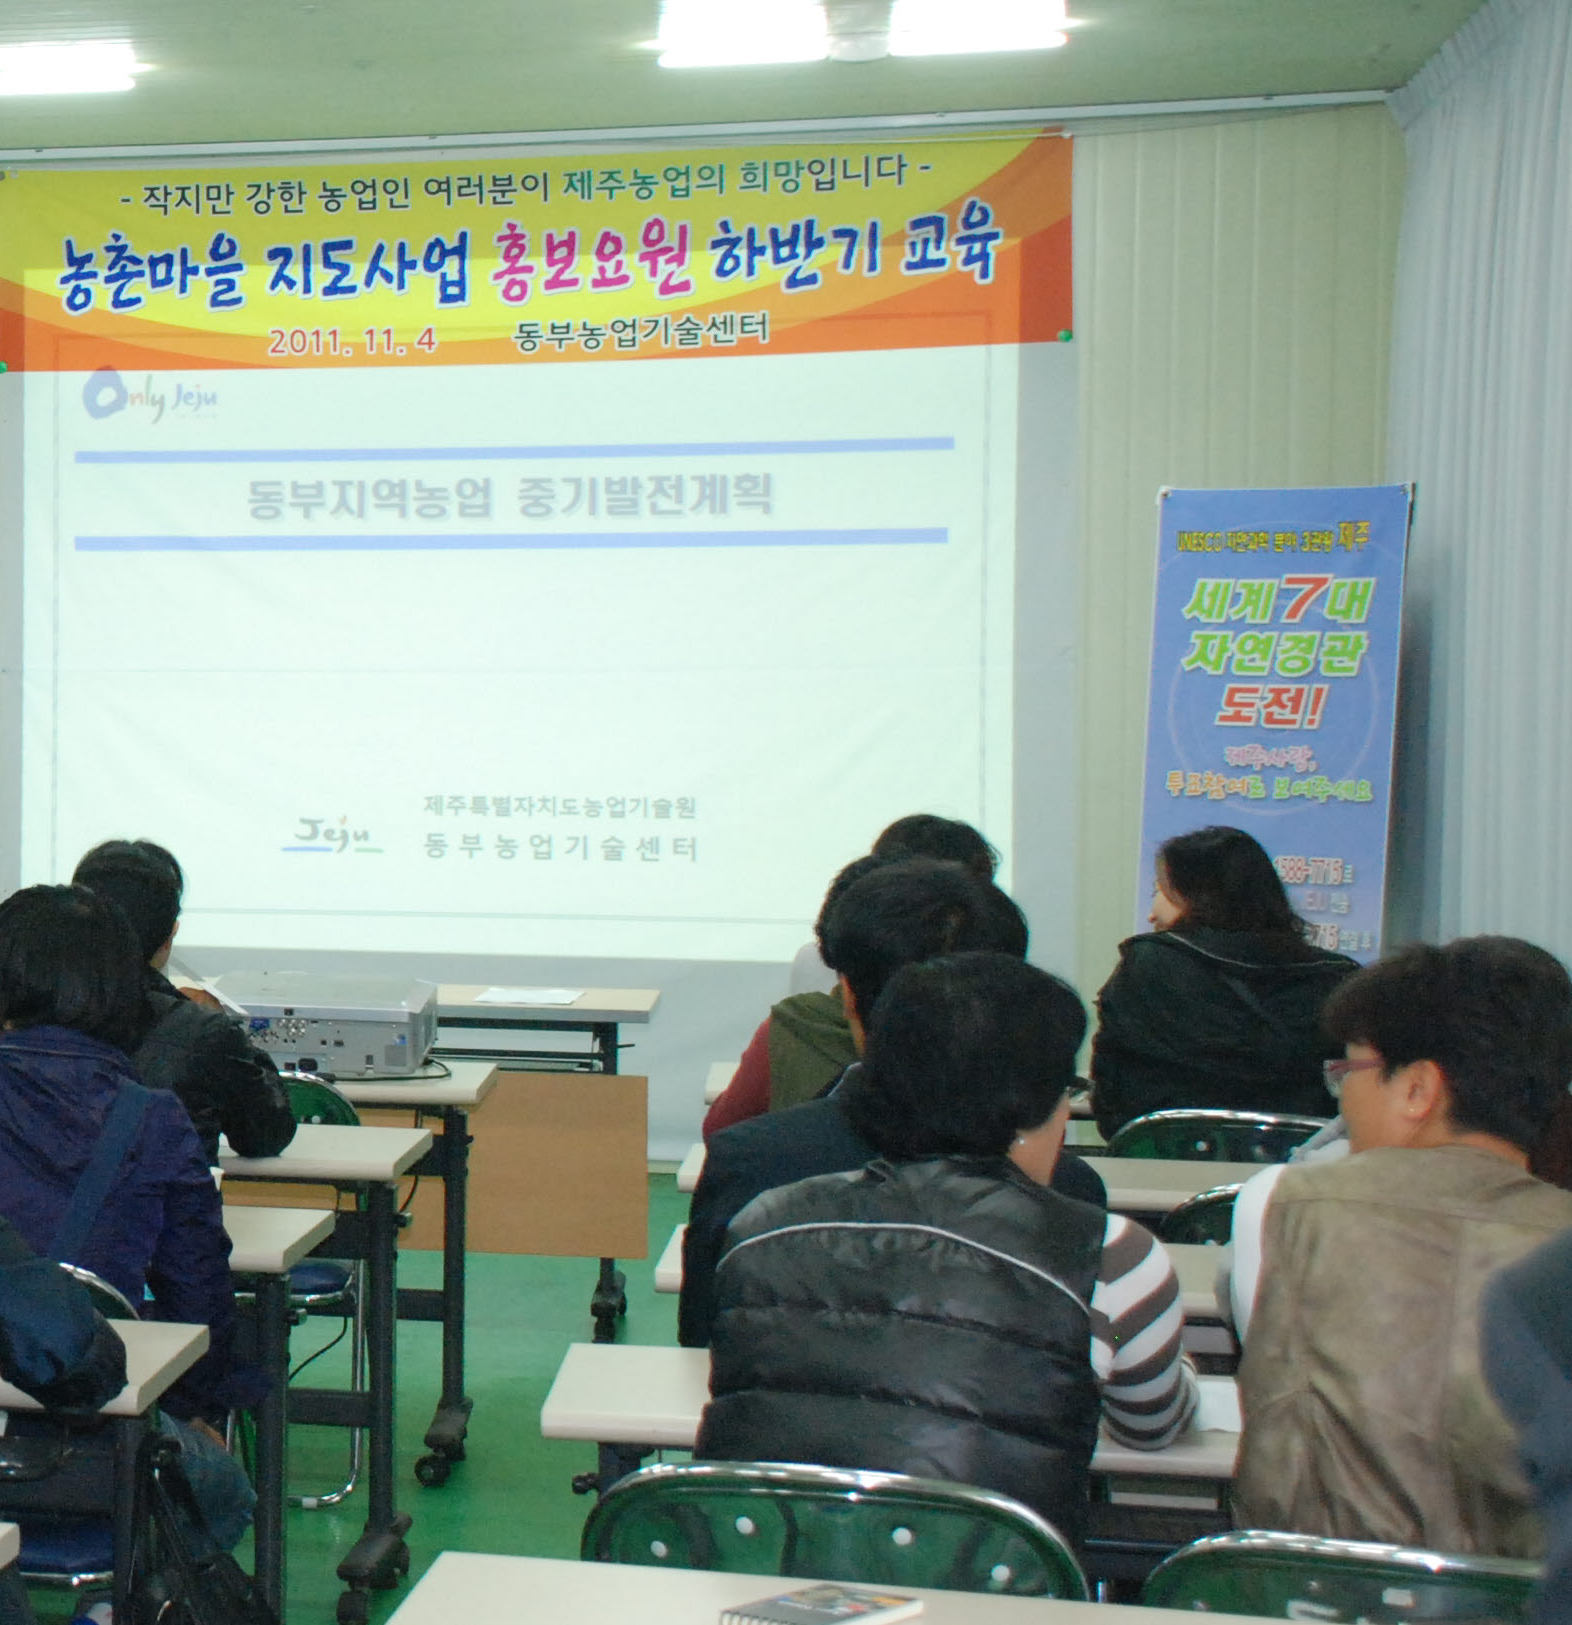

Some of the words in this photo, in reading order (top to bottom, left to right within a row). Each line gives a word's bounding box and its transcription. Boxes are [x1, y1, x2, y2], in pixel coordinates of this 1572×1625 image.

[143, 183, 234, 217] 작지만
[245, 180, 308, 214] 강한
[318, 177, 410, 214] 농업인
[423, 171, 549, 207] 여러분이
[563, 162, 725, 201] 제주농업의
[739, 154, 908, 193] 희망입니다
[59, 231, 245, 312] 농촌마을
[266, 230, 470, 305] 지도사업
[492, 215, 693, 303] 홍보요원
[710, 215, 881, 291] 하반기
[901, 198, 1001, 283] 교육
[269, 327, 353, 356] 2011.
[364, 326, 405, 354] 11.
[415, 326, 436, 352] 4
[513, 312, 770, 352] 동부농업기술센터
[82, 366, 166, 424] Only
[171, 384, 218, 412] Jeju
[248, 477, 494, 521] 동부지역농업
[518, 472, 774, 519] 중기발전계획
[1181, 574, 1376, 624] 세계7대
[1180, 630, 1369, 677] 자연경관
[1214, 683, 1330, 729] 도전!
[423, 794, 698, 820] 제주특별자치도농업기술원
[1166, 770, 1267, 800] 투표참여로
[1273, 775, 1373, 803] 보여주세요
[294, 815, 370, 854] Jeju
